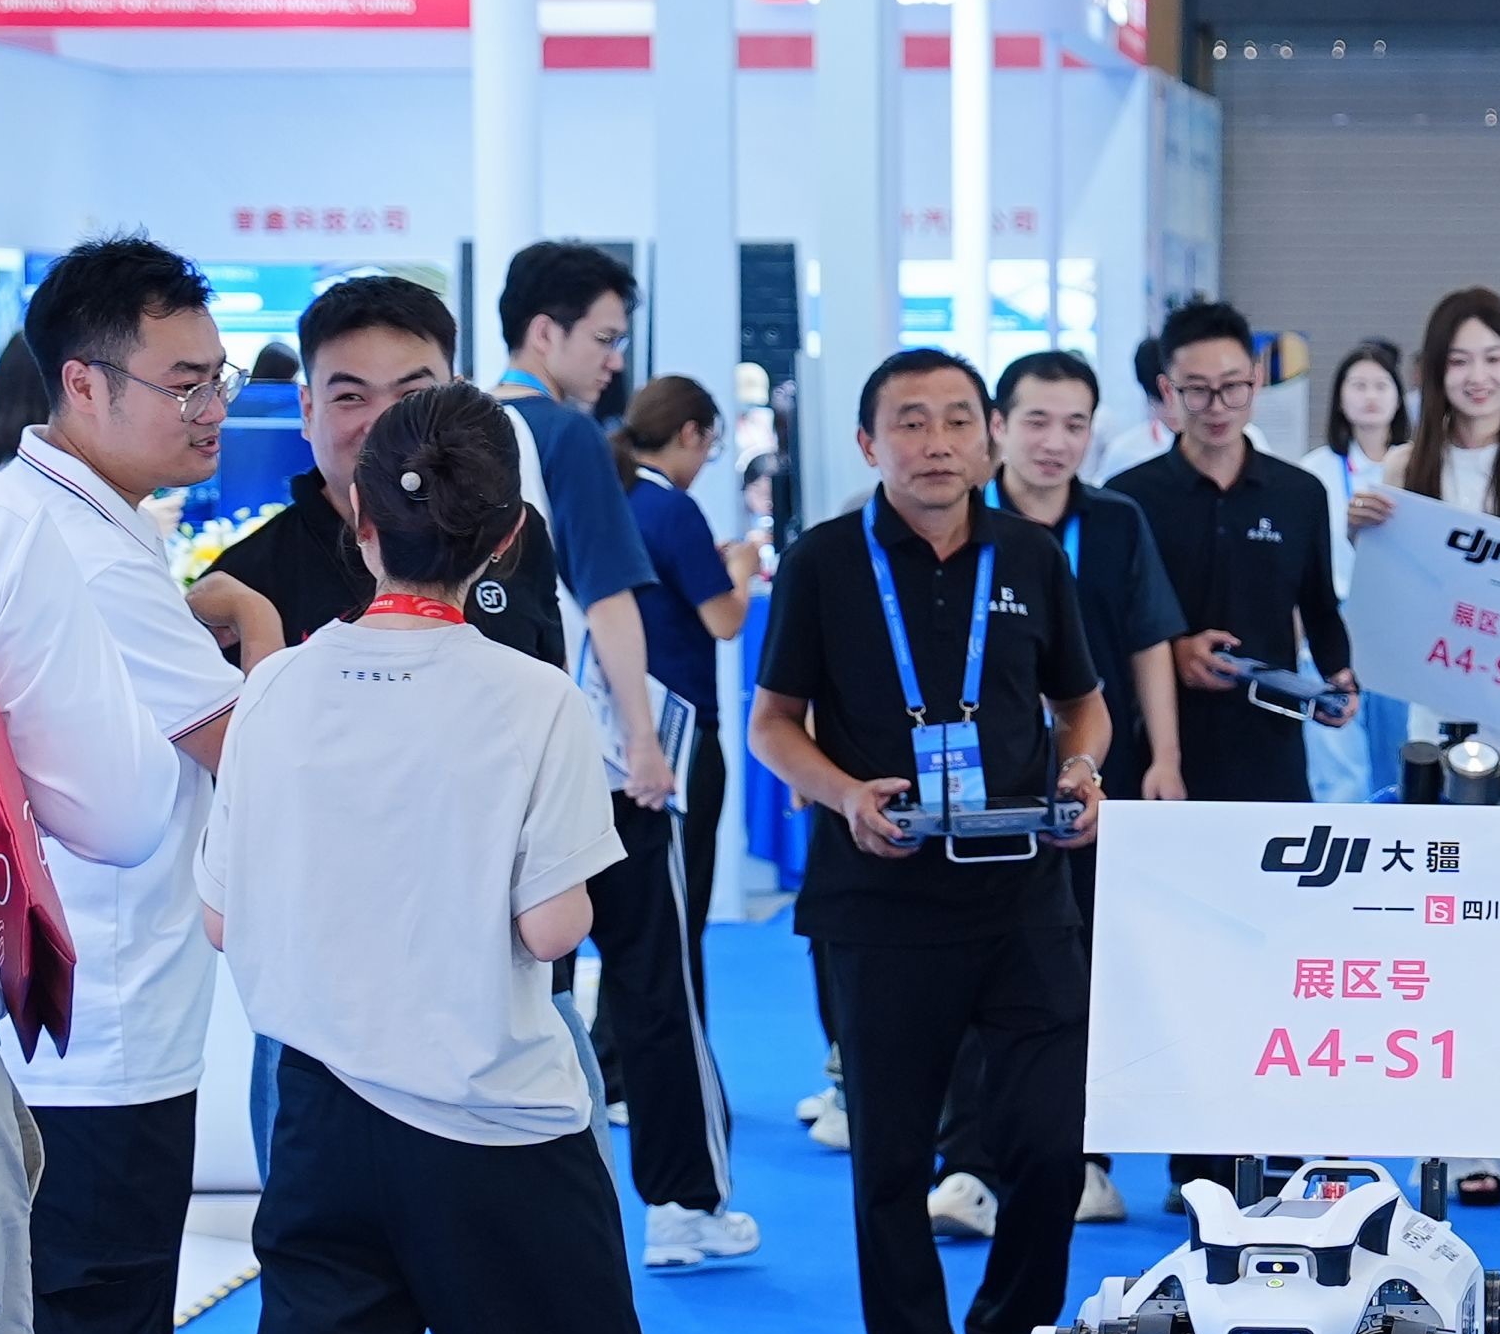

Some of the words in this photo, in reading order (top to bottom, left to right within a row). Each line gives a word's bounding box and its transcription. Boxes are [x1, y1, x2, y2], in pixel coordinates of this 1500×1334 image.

[341, 670, 412, 681] TESLA
[1382, 840, 1460, 873] 大疆
[1293, 958, 1430, 1000] 展区号
[1255, 1028, 1454, 1079] A4-S1
